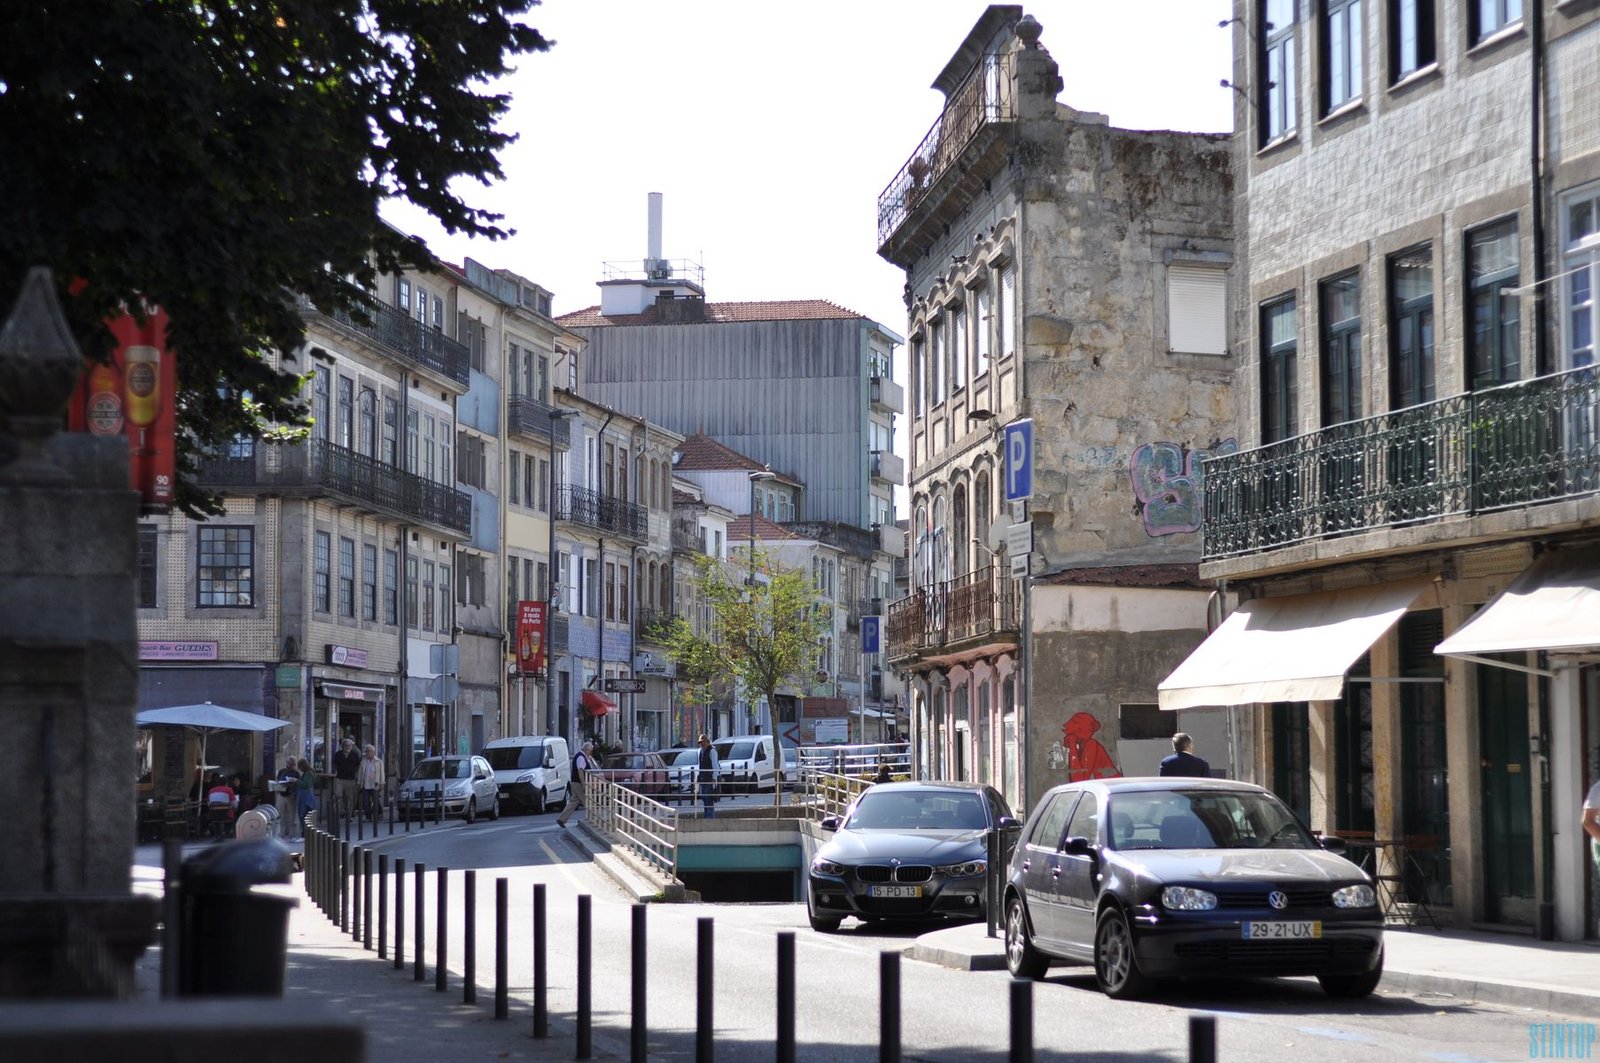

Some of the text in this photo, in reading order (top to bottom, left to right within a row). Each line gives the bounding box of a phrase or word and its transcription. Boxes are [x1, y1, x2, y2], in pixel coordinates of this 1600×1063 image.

[1010, 431, 1026, 494] P
[156, 475, 169, 485] 90
[866, 622, 877, 648] P
[174, 644, 212, 652] GUEDES
